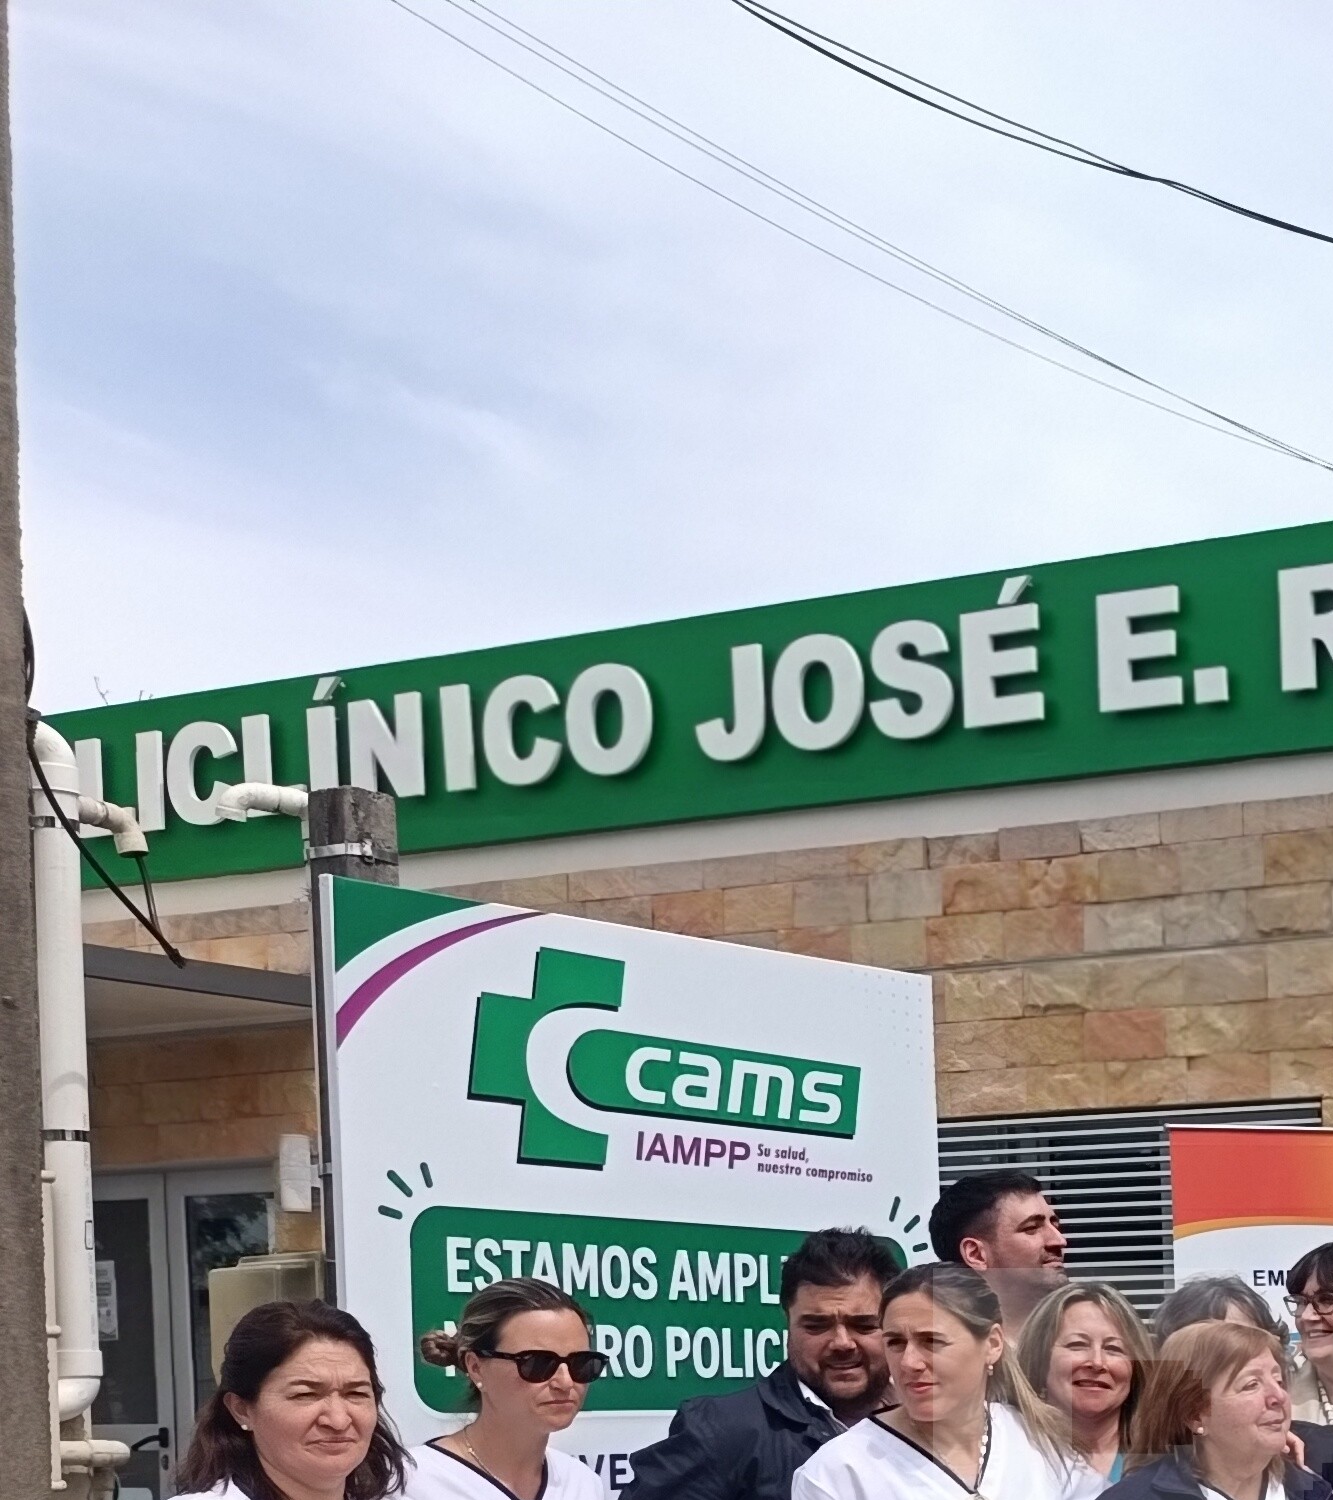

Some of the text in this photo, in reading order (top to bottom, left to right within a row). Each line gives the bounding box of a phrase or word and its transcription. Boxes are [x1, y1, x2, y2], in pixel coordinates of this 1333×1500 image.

[75, 676, 653, 839] LICLÍNICO
[695, 574, 1045, 762] JOSÉ
[1095, 585, 1228, 713] E.
[625, 1046, 844, 1124] cams
[635, 1131, 750, 1169] IAMPP
[757, 1143, 809, 1163] Su salud,
[757, 1162, 873, 1182] nuestro compromiso
[446, 1236, 787, 1304] ESTAMOS AMPL
